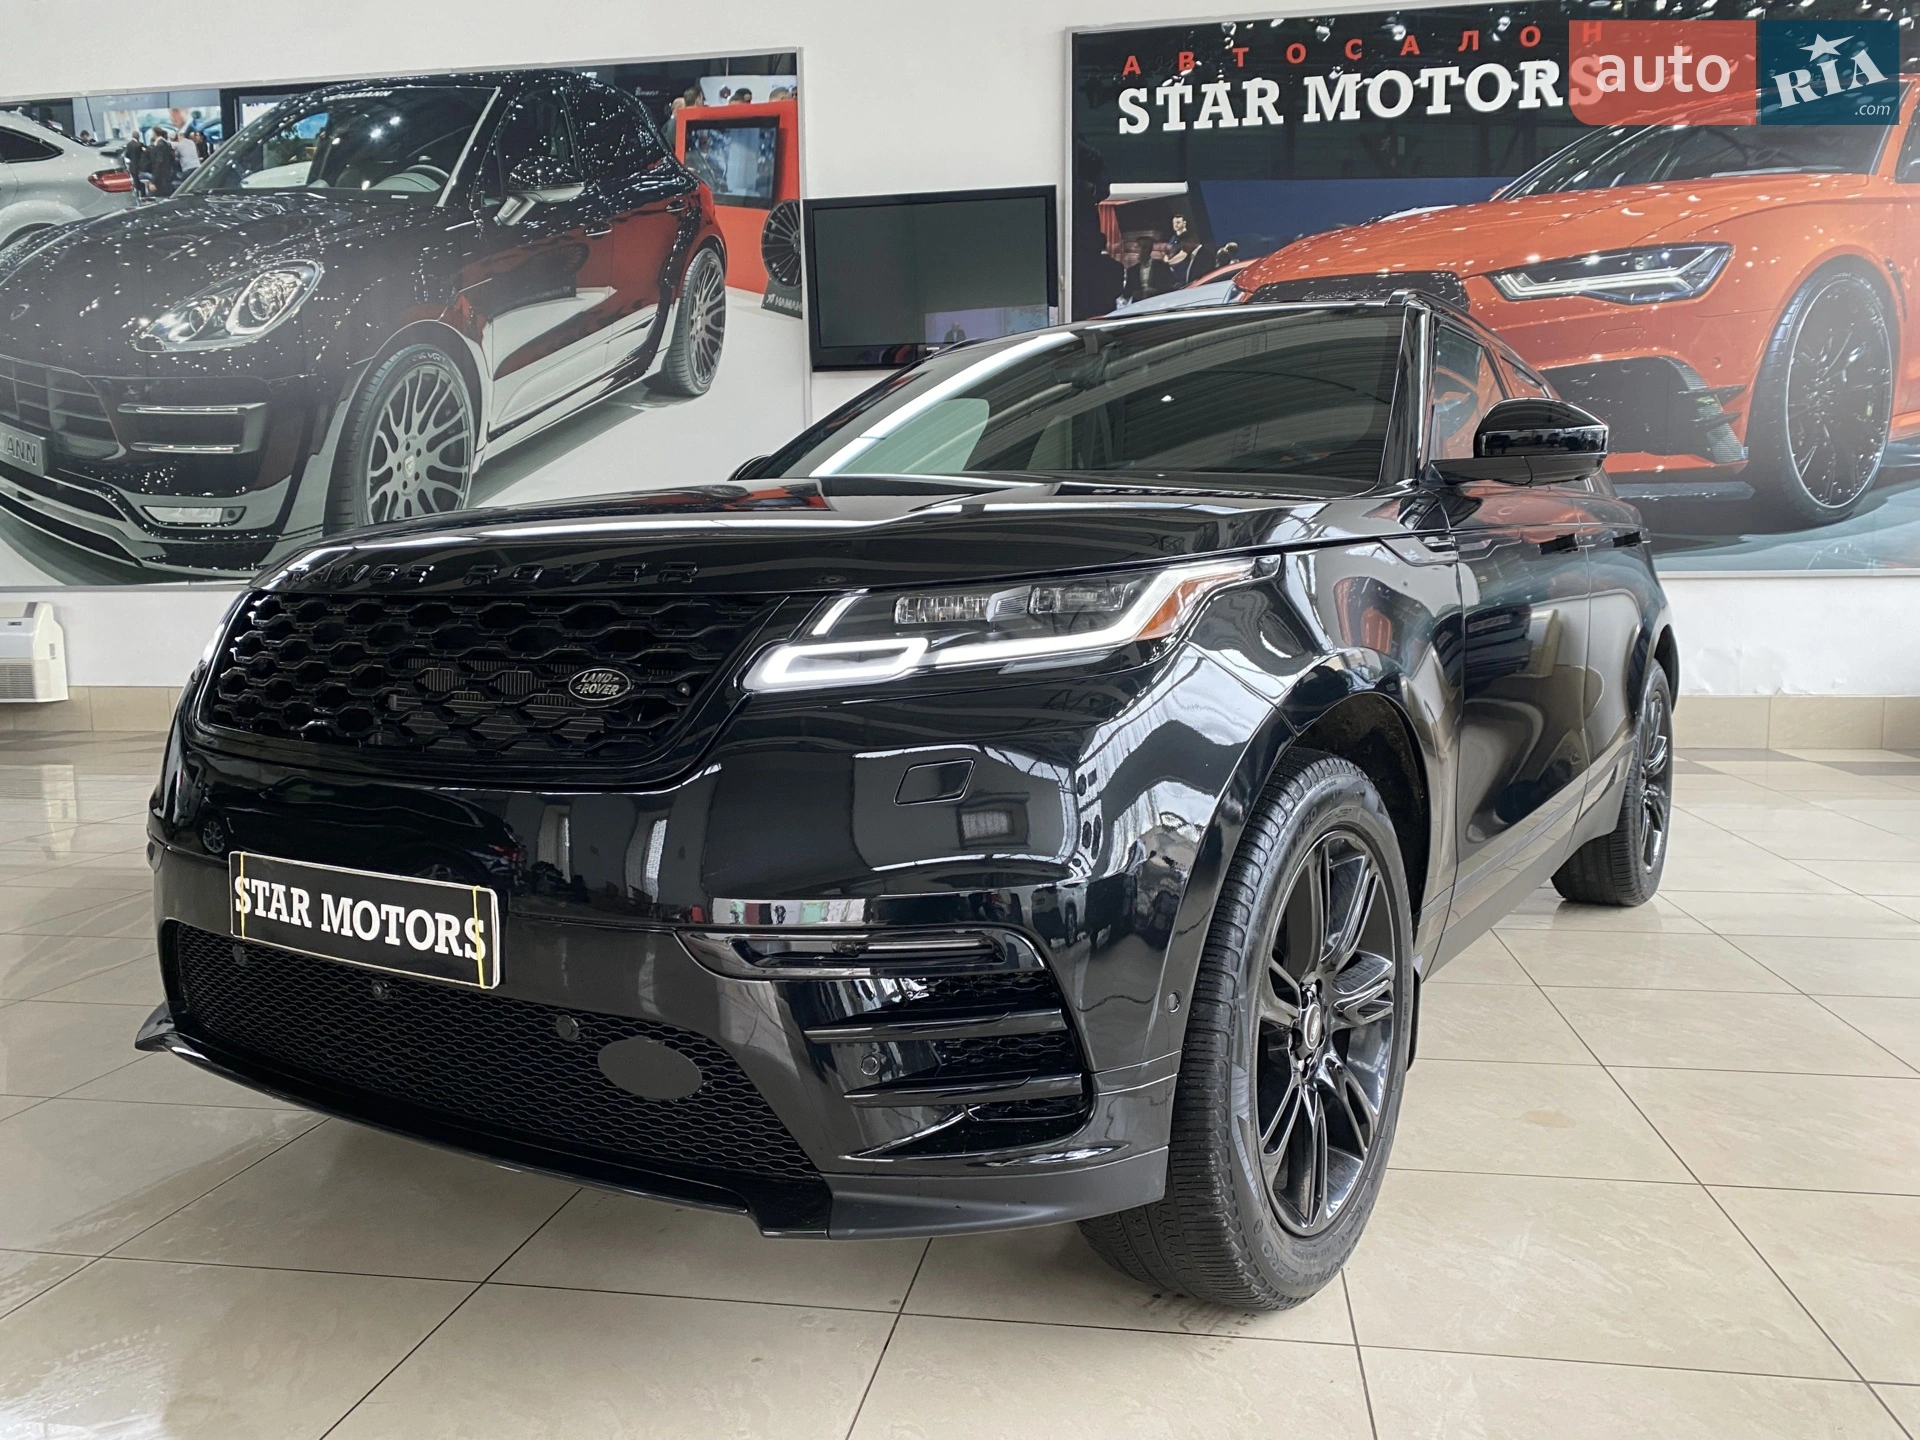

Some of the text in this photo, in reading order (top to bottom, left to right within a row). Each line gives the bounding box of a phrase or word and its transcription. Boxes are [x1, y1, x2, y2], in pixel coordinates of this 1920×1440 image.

[1118, 53, 1605, 134] STAR MOTORS
[286, 562, 698, 585] RANGE ROVER
[580, 683, 619, 695] ROVER
[581, 673, 613, 683] LAND
[234, 875, 486, 961] STAR MOTORS
